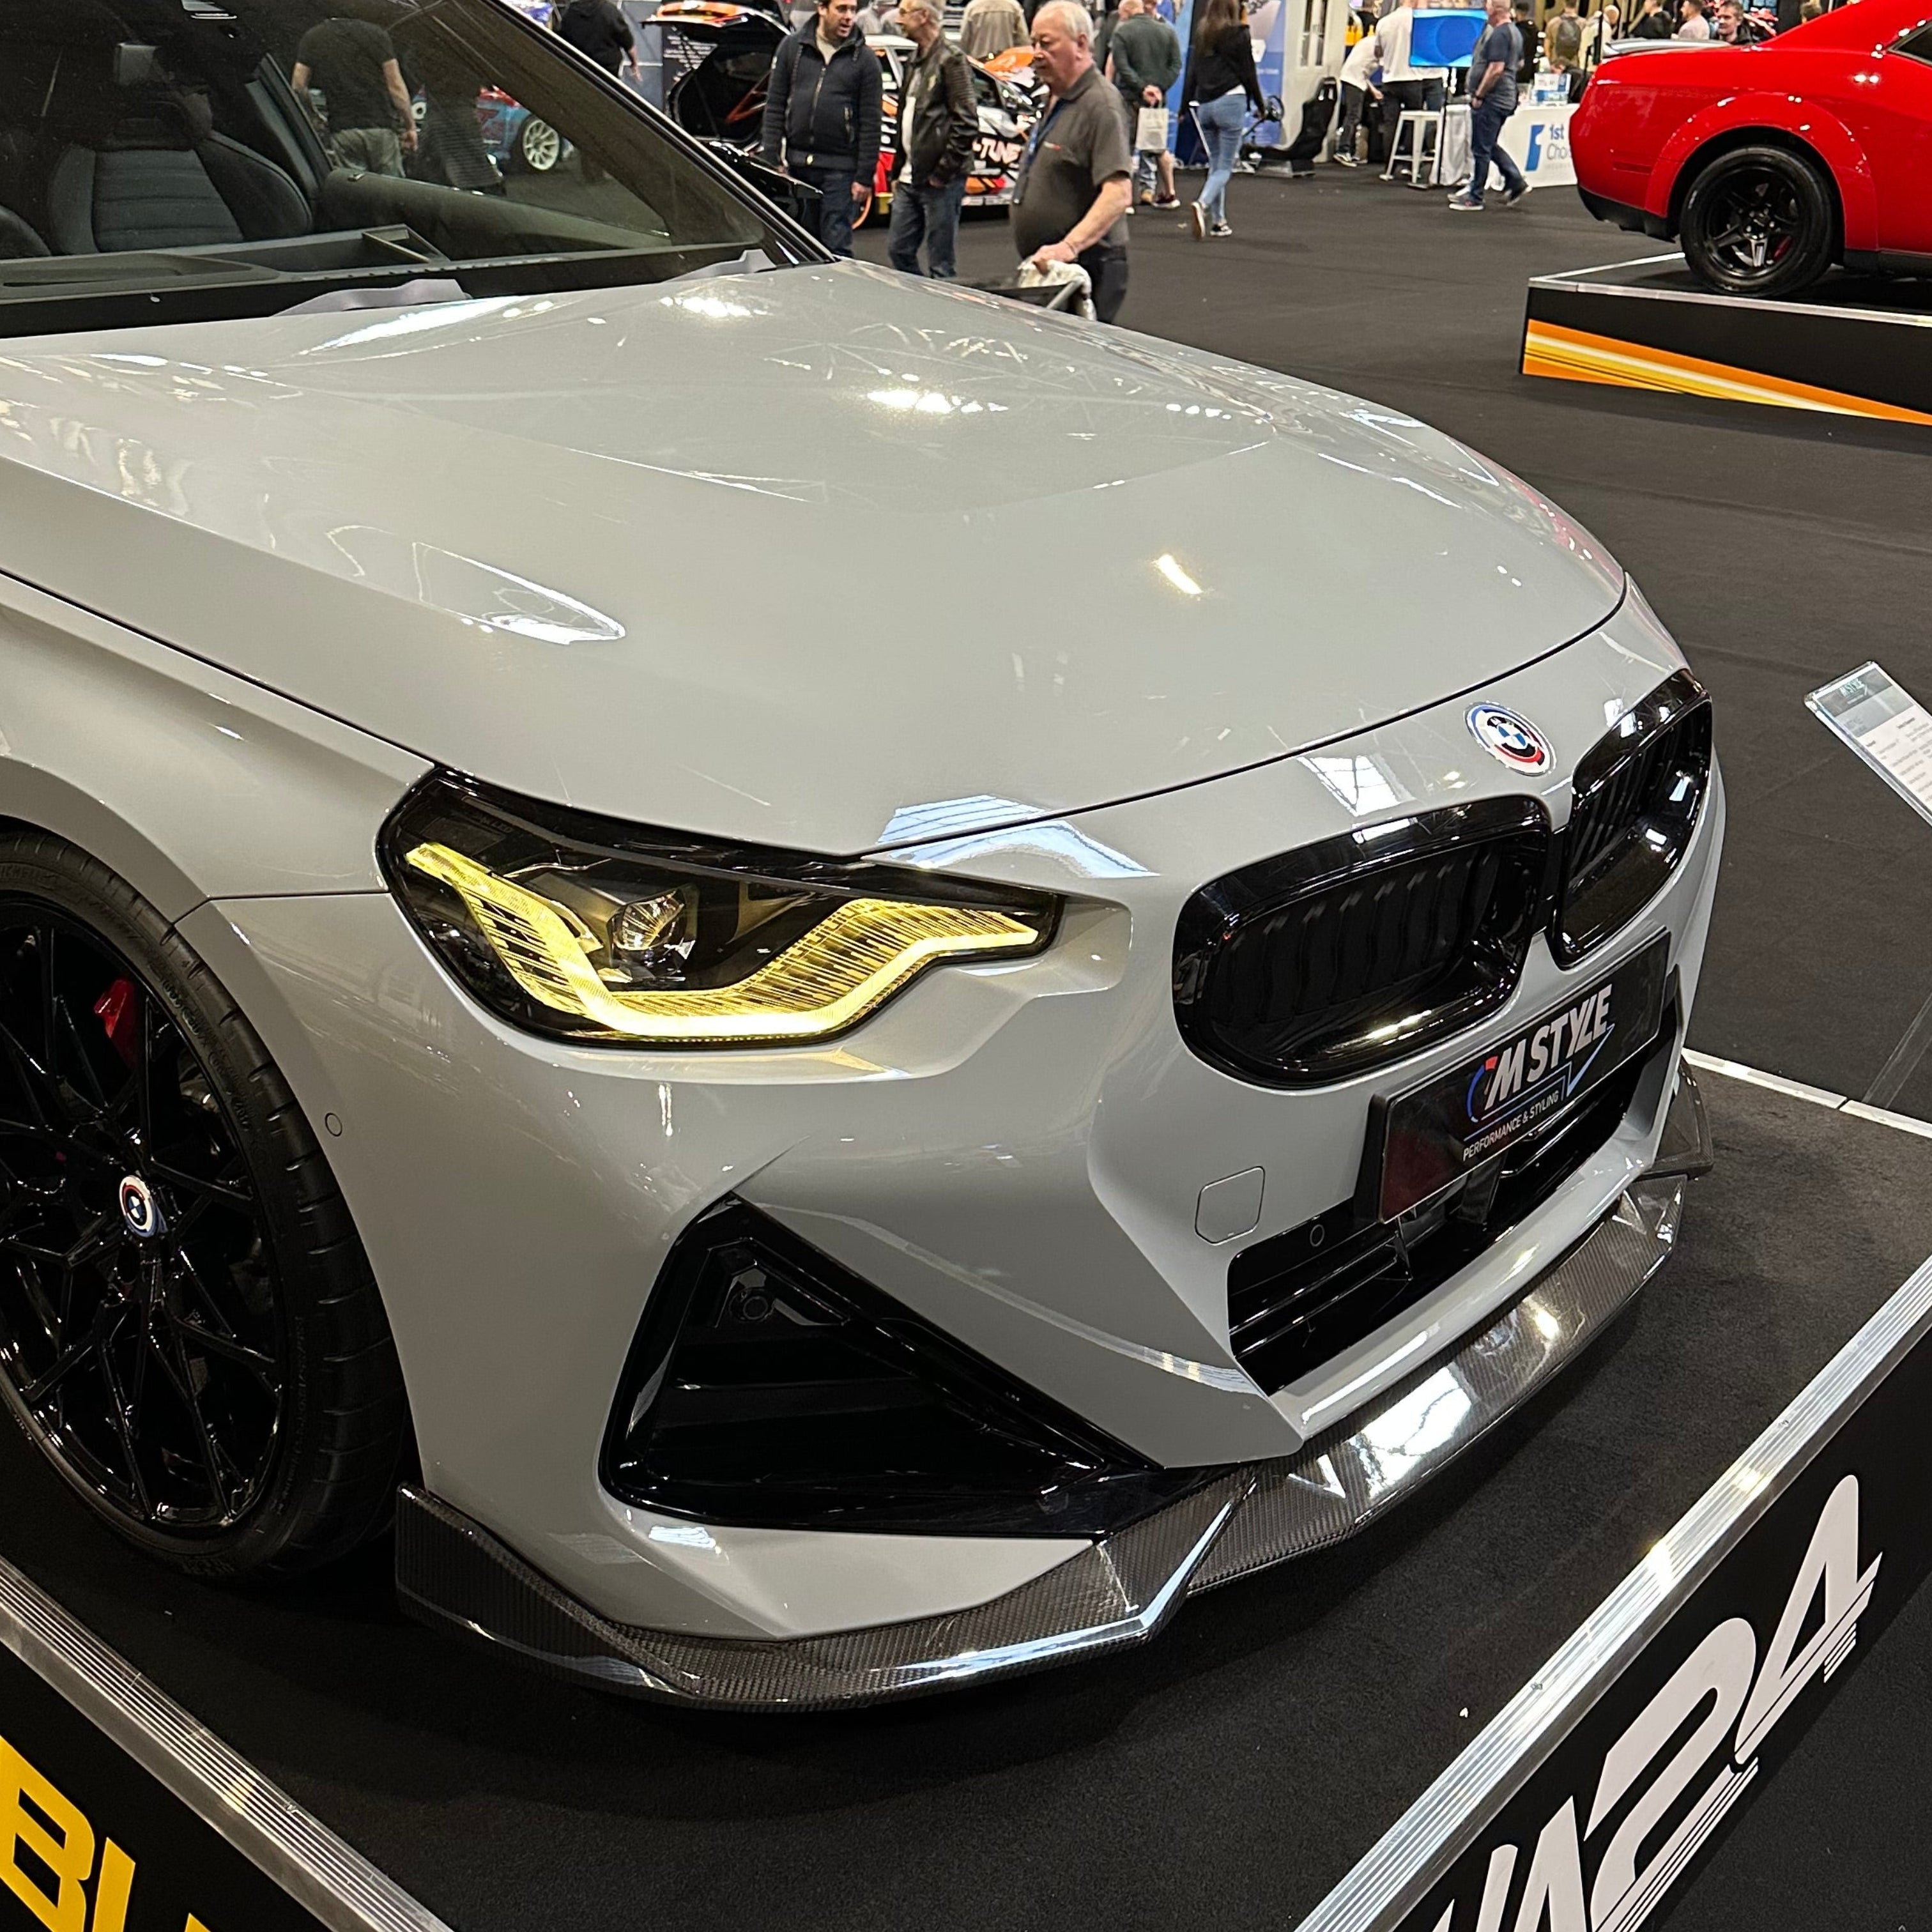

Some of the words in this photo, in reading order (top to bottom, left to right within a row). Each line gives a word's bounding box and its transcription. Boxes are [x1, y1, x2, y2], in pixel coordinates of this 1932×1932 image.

[1549, 124, 1565, 140] 1st
[1462, 1117, 1522, 1162] PERFORMANCE
[1522, 1111, 1529, 1124] &
[1529, 1090, 1560, 1119] STYLING
